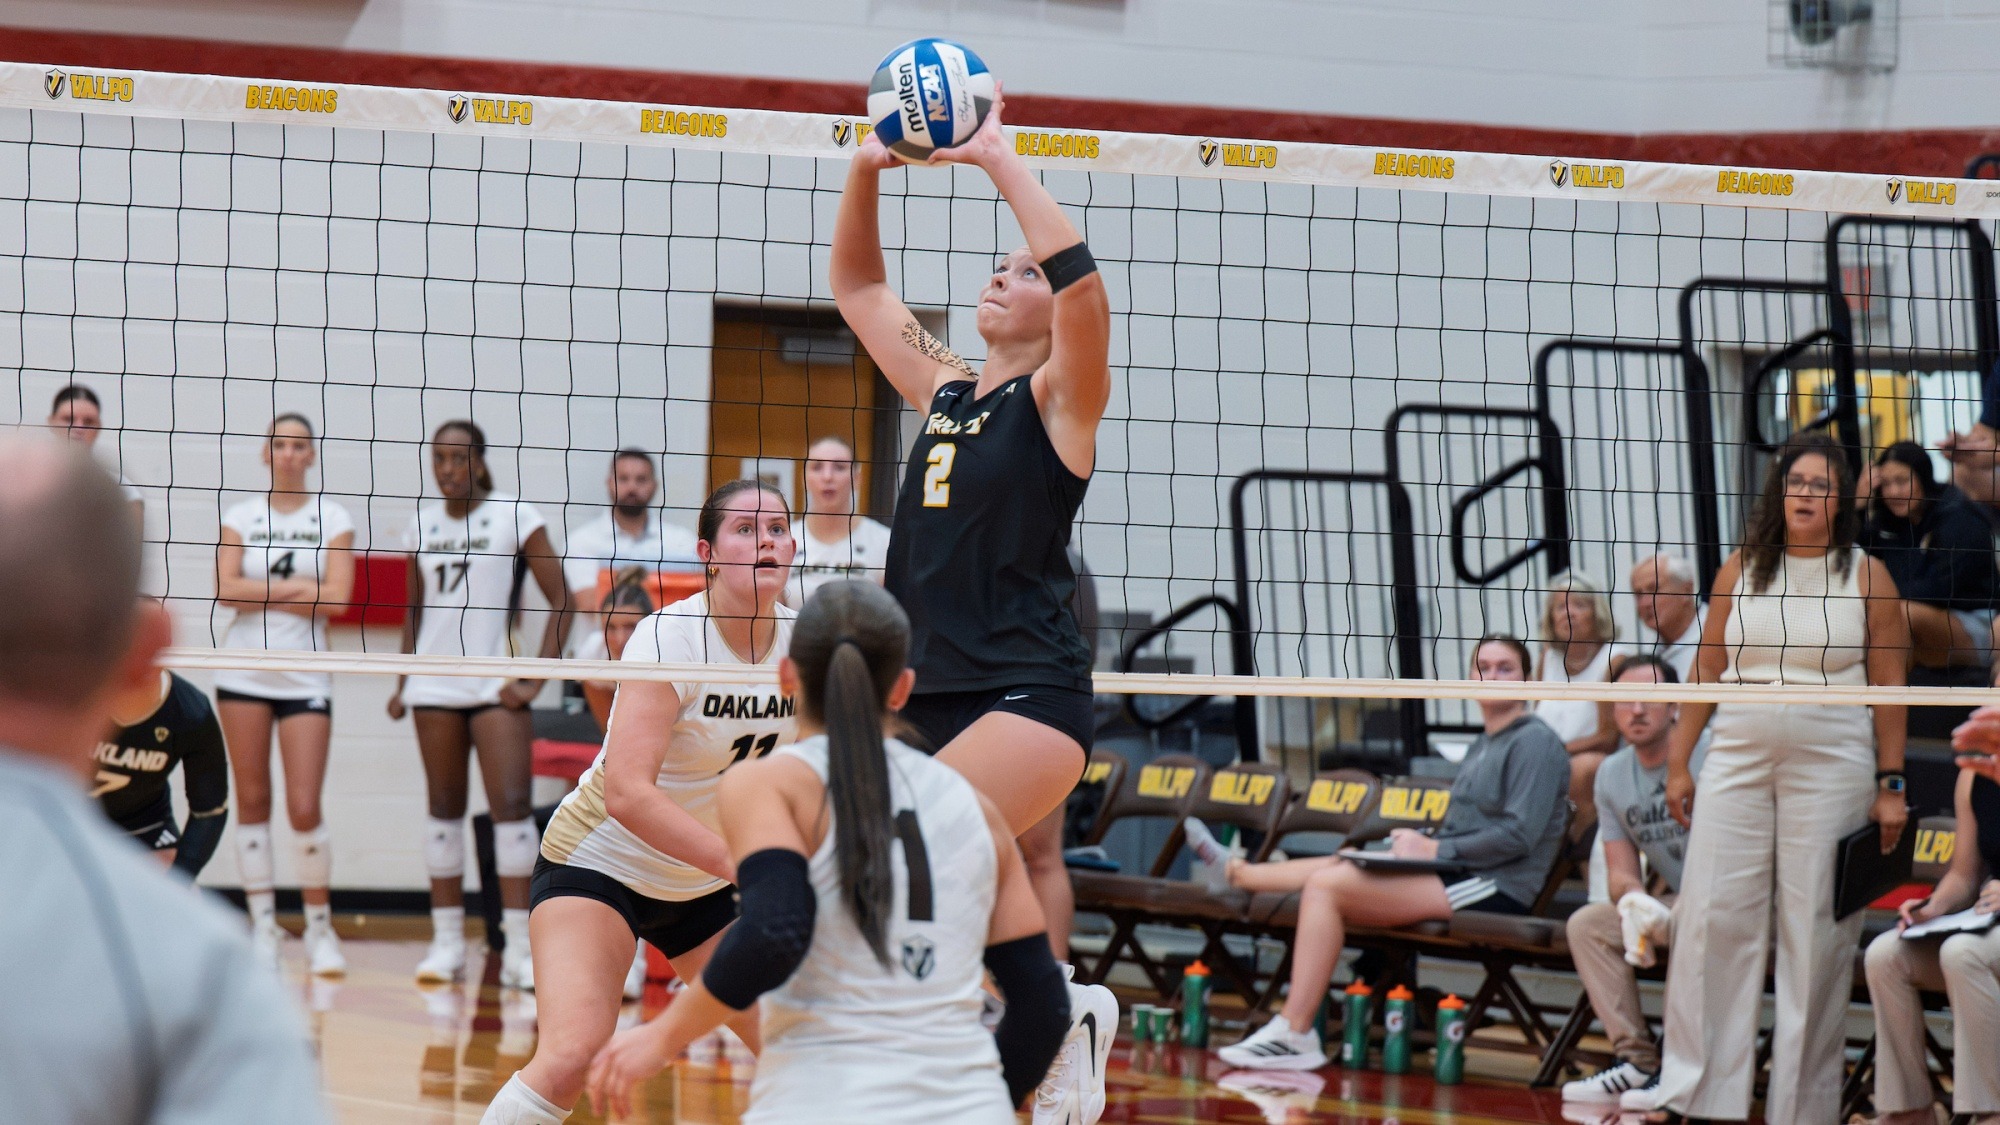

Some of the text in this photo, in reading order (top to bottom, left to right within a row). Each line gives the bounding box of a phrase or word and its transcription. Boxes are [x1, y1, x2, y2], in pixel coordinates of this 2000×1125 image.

[69, 73, 134, 102] VALPO
[245, 84, 338, 114] BEACONS
[900, 62, 925, 133] molten
[918, 63, 950, 122] NCAA
[472, 98, 533, 126] VALPO
[639, 109, 729, 139] BEACONS
[1014, 132, 1101, 159] BEACONS
[1222, 143, 1278, 169] VALPO
[1373, 152, 1456, 180] BEACONS
[1571, 165, 1625, 189] VALPO
[1716, 170, 1795, 197] BEACONS
[1905, 181, 1957, 206] VALPO
[923, 442, 957, 508] 2
[269, 551, 296, 579] 4
[435, 561, 471, 593] 17
[703, 694, 796, 719] OAKLAN
[94, 742, 169, 772] KLAND
[1208, 772, 1276, 806] VALPO
[1306, 779, 1368, 814] VALPO
[1380, 788, 1451, 822] VALPO
